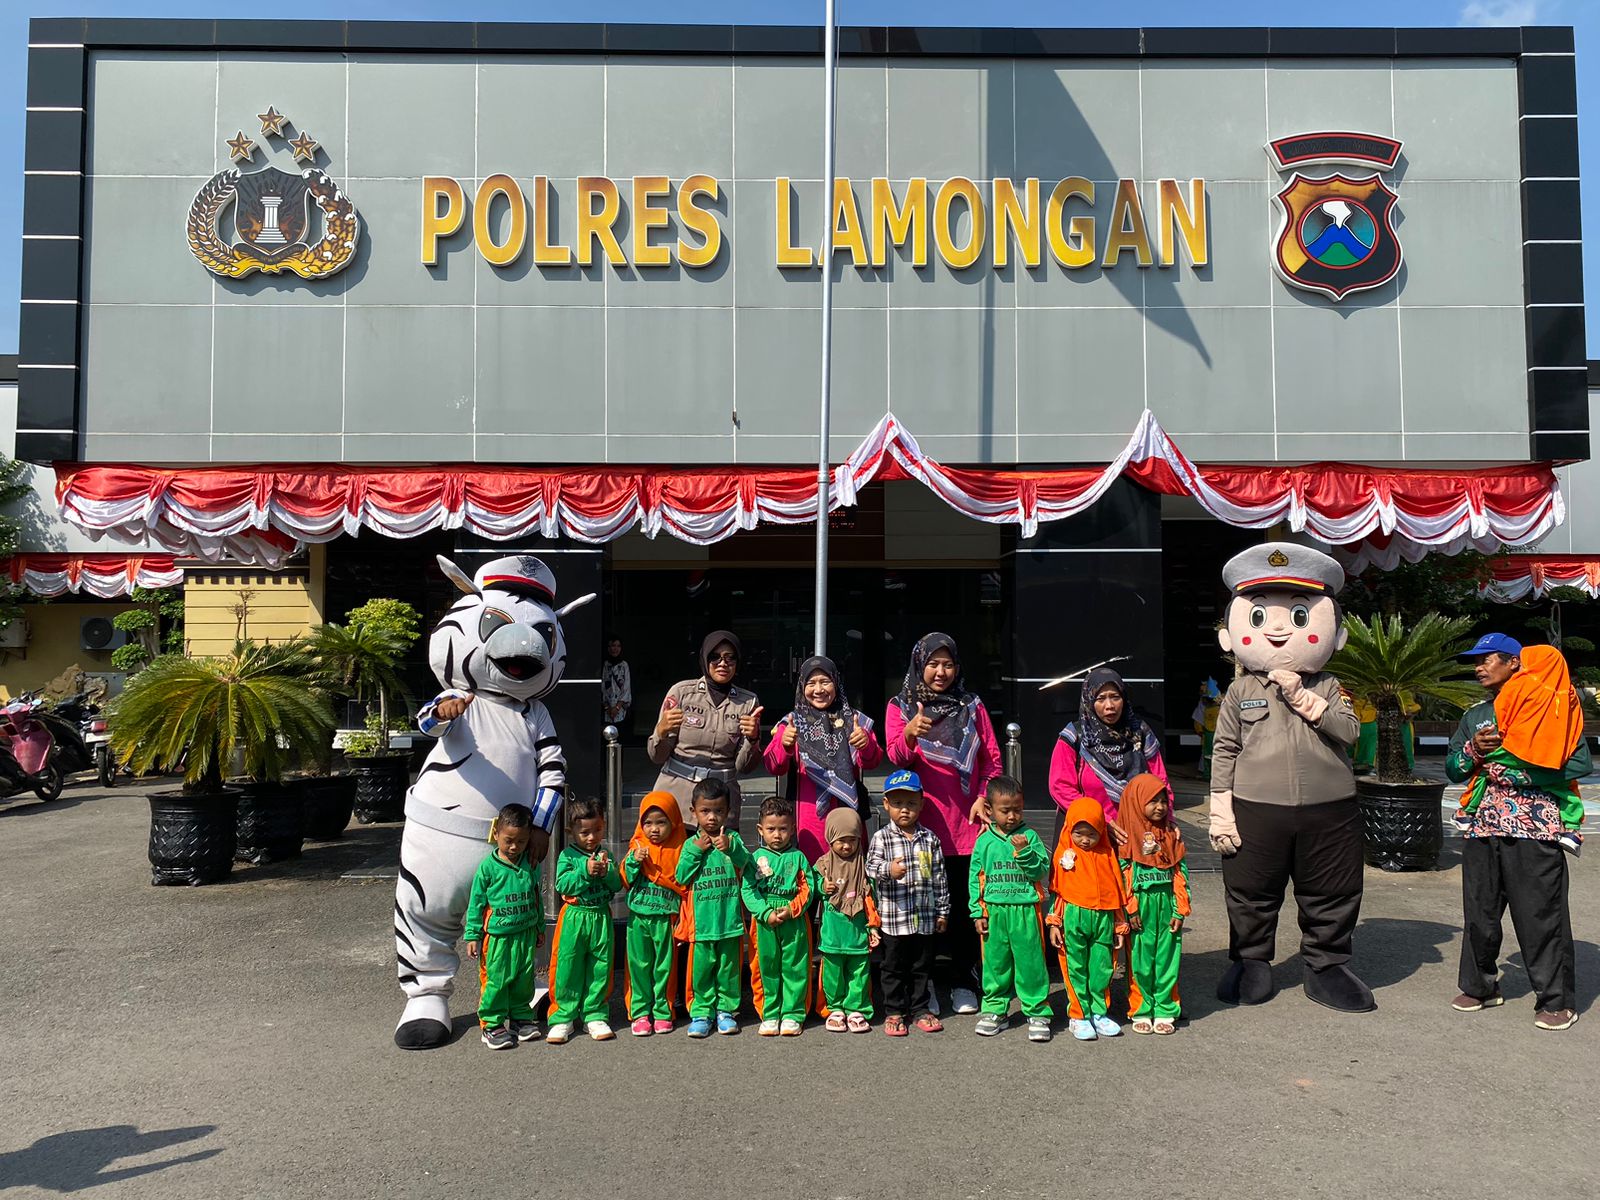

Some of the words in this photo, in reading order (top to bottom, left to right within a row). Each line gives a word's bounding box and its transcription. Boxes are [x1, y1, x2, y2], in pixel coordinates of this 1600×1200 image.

[421, 173, 722, 268] POLRES
[775, 176, 1210, 269] LAMONGAN
[684, 704, 704, 715] AYU
